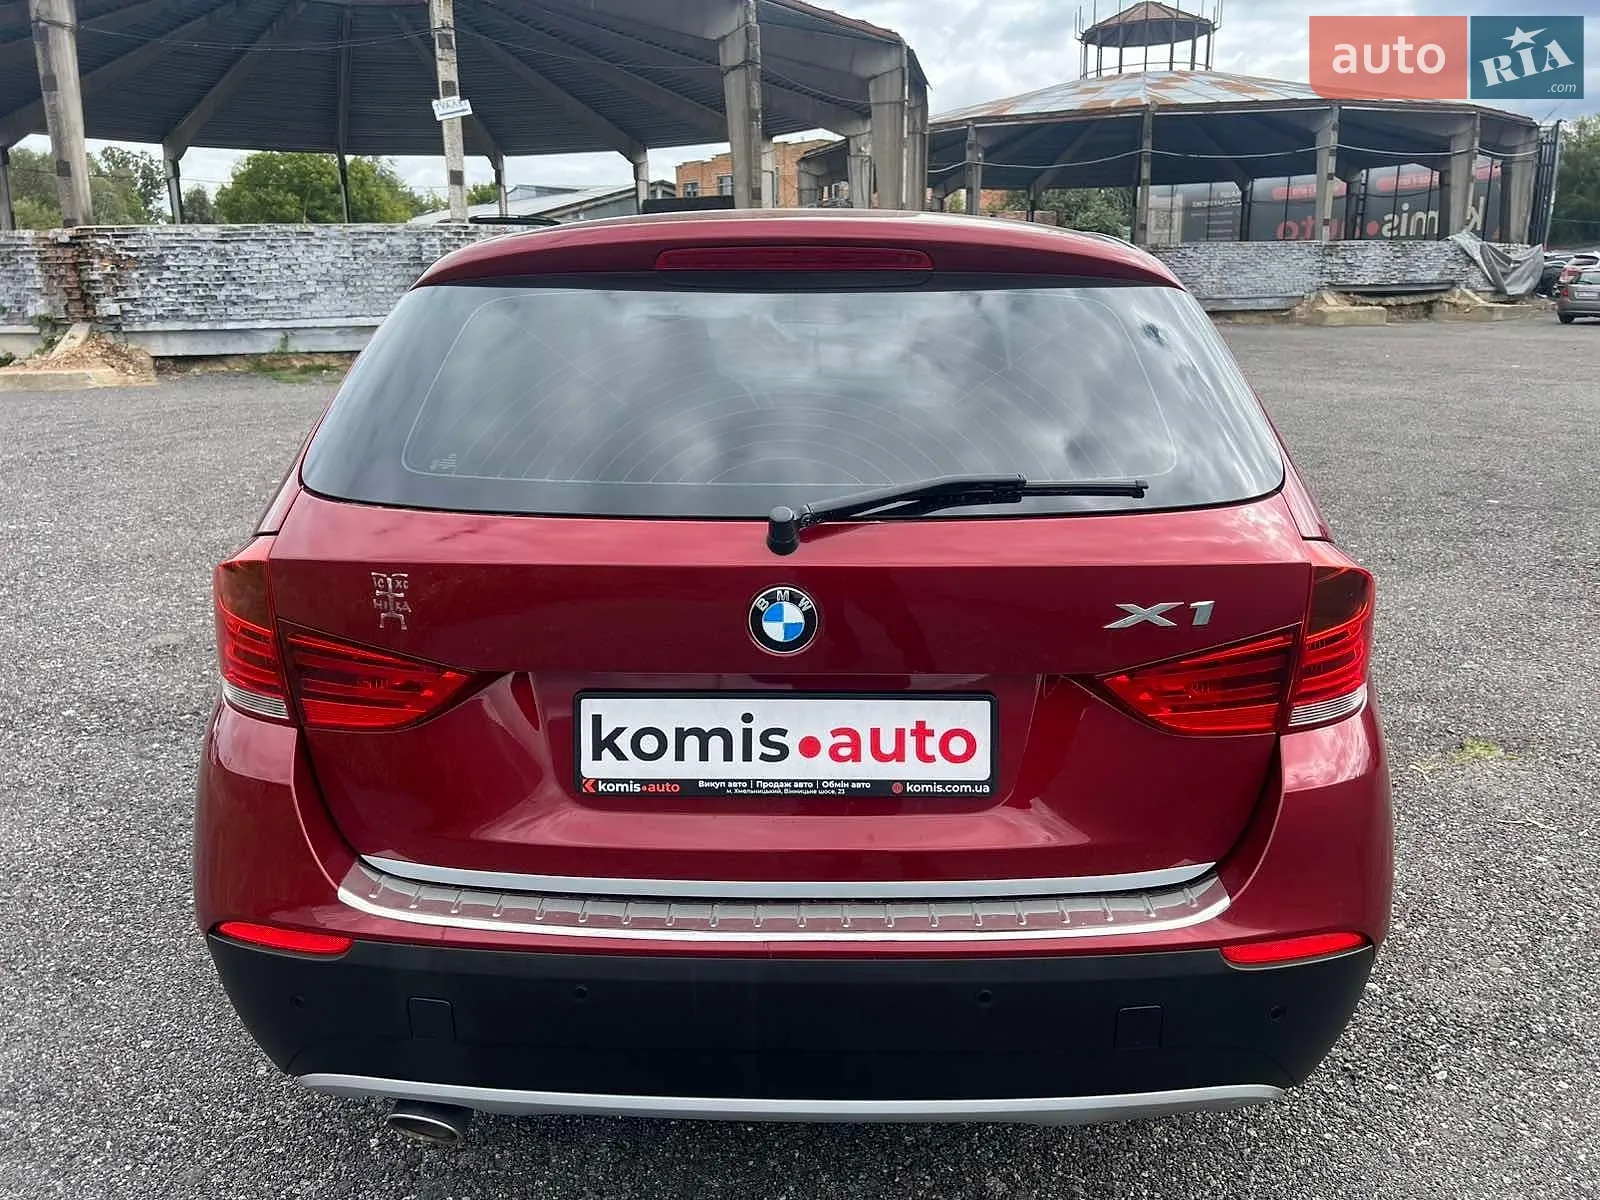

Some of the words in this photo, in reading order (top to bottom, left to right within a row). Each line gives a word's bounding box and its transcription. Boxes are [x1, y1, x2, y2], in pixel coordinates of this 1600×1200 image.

[755, 589, 812, 612] BMW
[1102, 600, 1215, 628] X1
[698, 780, 726, 789] Викуп
[756, 780, 792, 789] Продаж
[821, 780, 850, 788] Обмін
[906, 781, 990, 793] komis.com.ua
